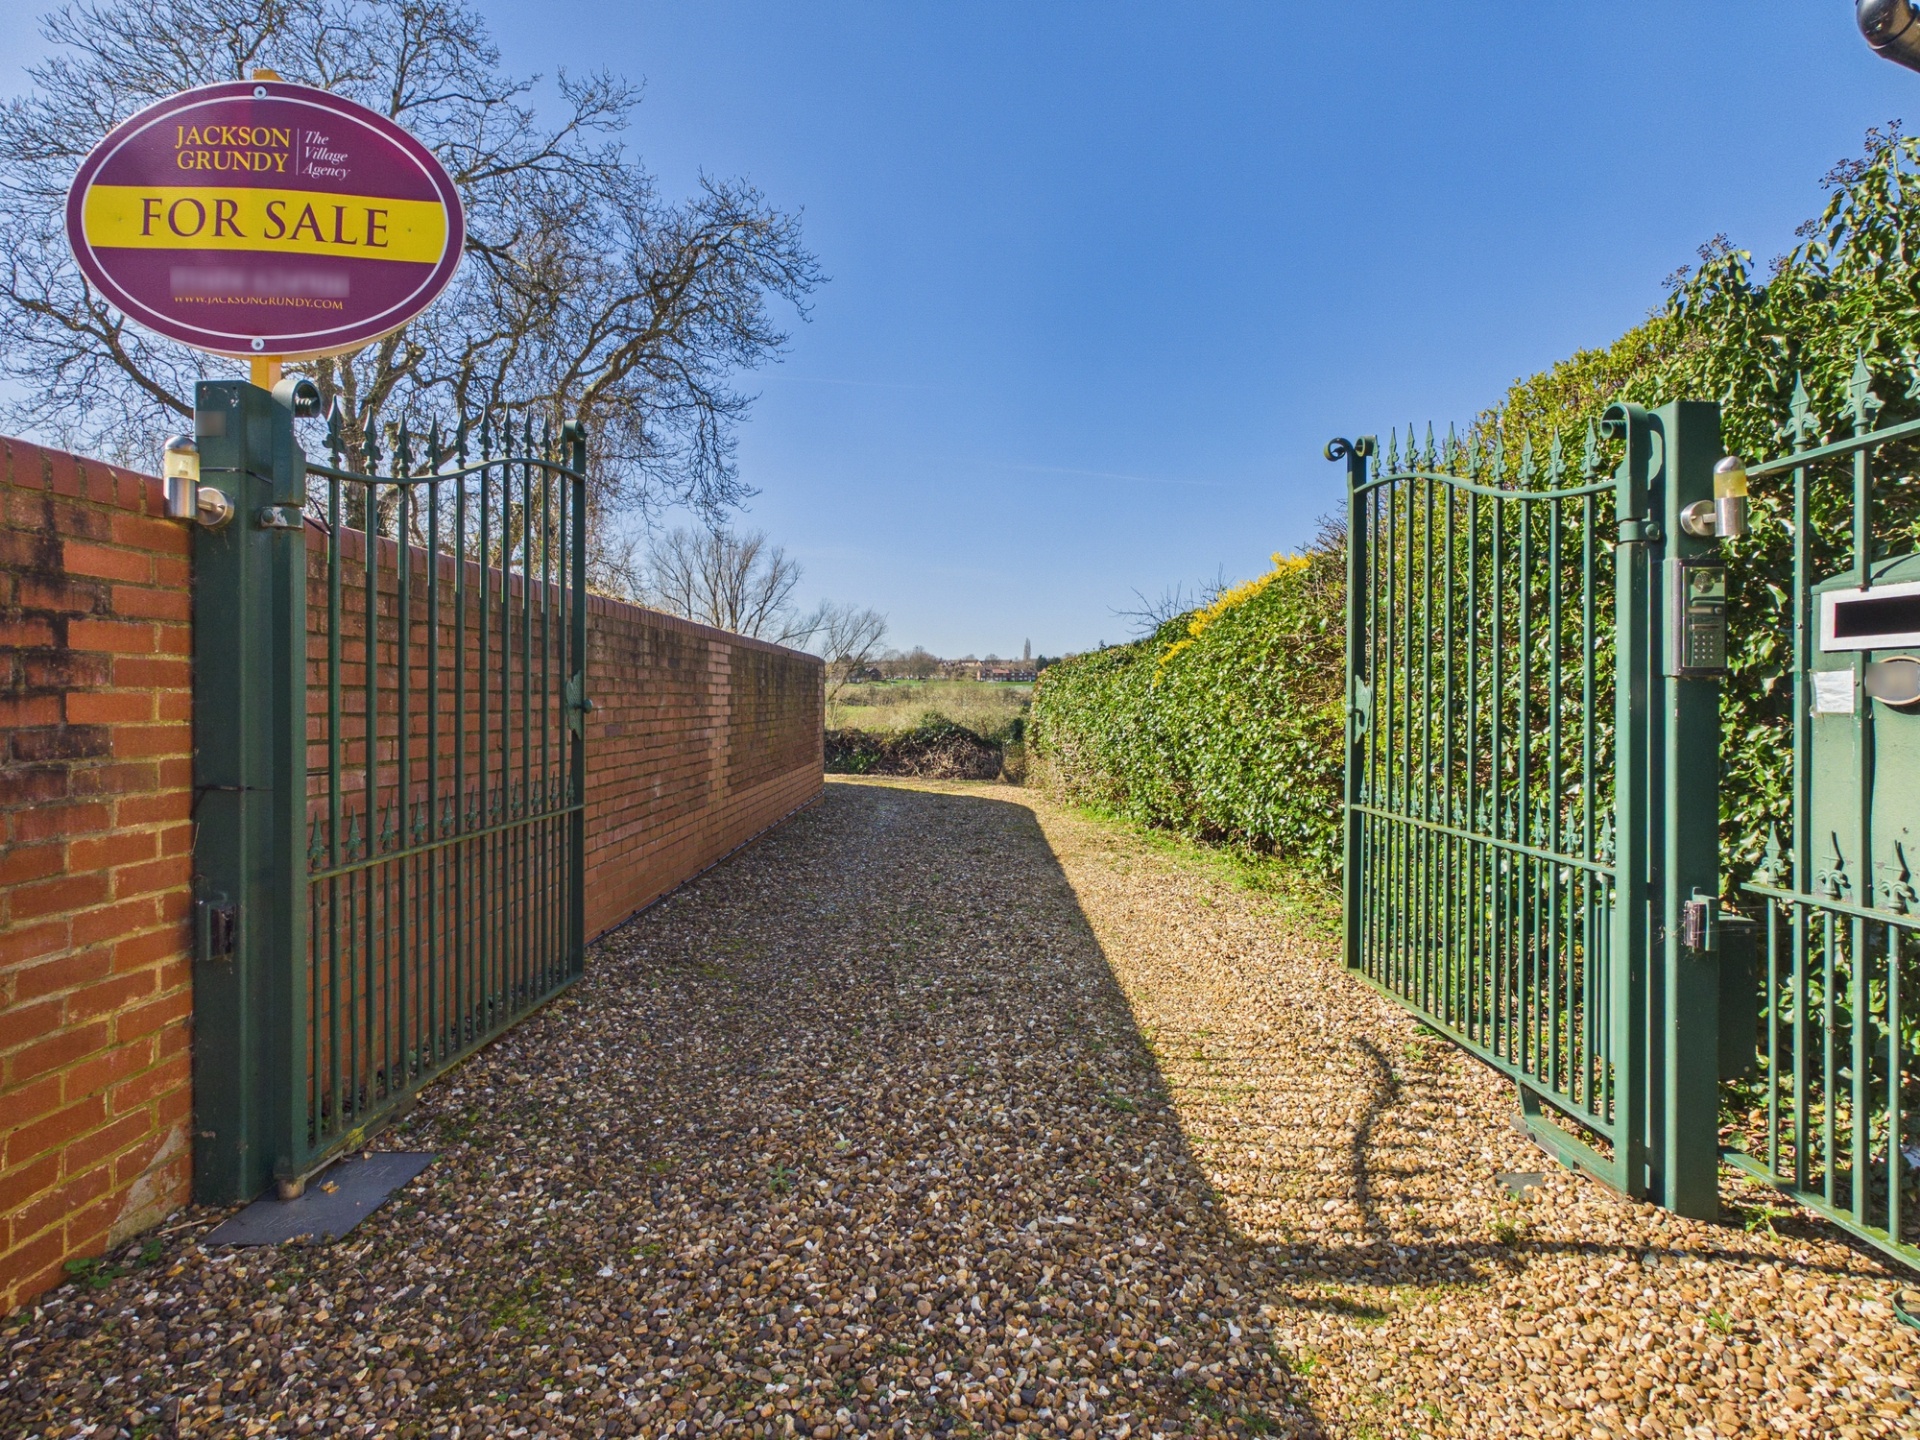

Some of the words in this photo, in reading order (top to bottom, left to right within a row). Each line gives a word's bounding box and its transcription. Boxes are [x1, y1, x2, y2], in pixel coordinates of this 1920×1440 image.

[174, 125, 291, 149] JACKSON
[304, 130, 330, 146] The
[176, 150, 289, 173] GRUNDY
[304, 146, 349, 166] Village
[302, 161, 351, 182] Agency
[139, 197, 247, 238] FOR
[263, 200, 389, 249] SALE
